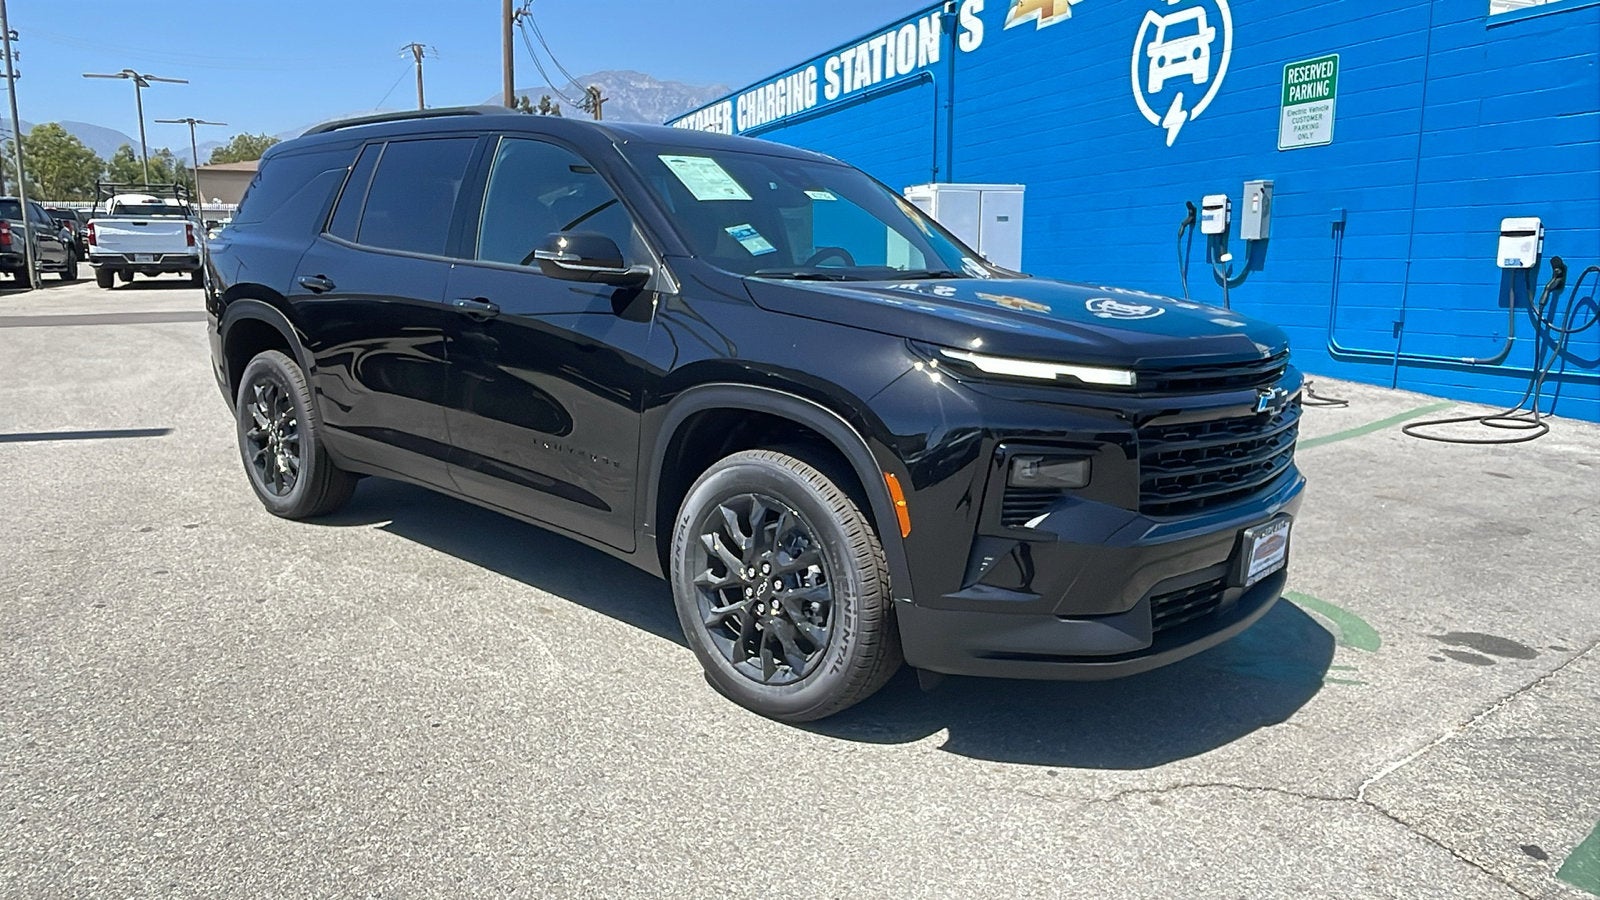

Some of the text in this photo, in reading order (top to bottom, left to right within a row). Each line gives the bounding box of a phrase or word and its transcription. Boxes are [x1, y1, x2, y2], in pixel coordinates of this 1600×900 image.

[1288, 60, 1334, 84] RESERVED
[1289, 80, 1330, 102] PARKING
[737, 65, 817, 131] CHARGING
[1287, 104, 1329, 117] Electric Vehicle
[1291, 113, 1323, 125] CUSTOMER
[1293, 122, 1320, 132] PARKING
[1297, 132, 1314, 140] ONLY
